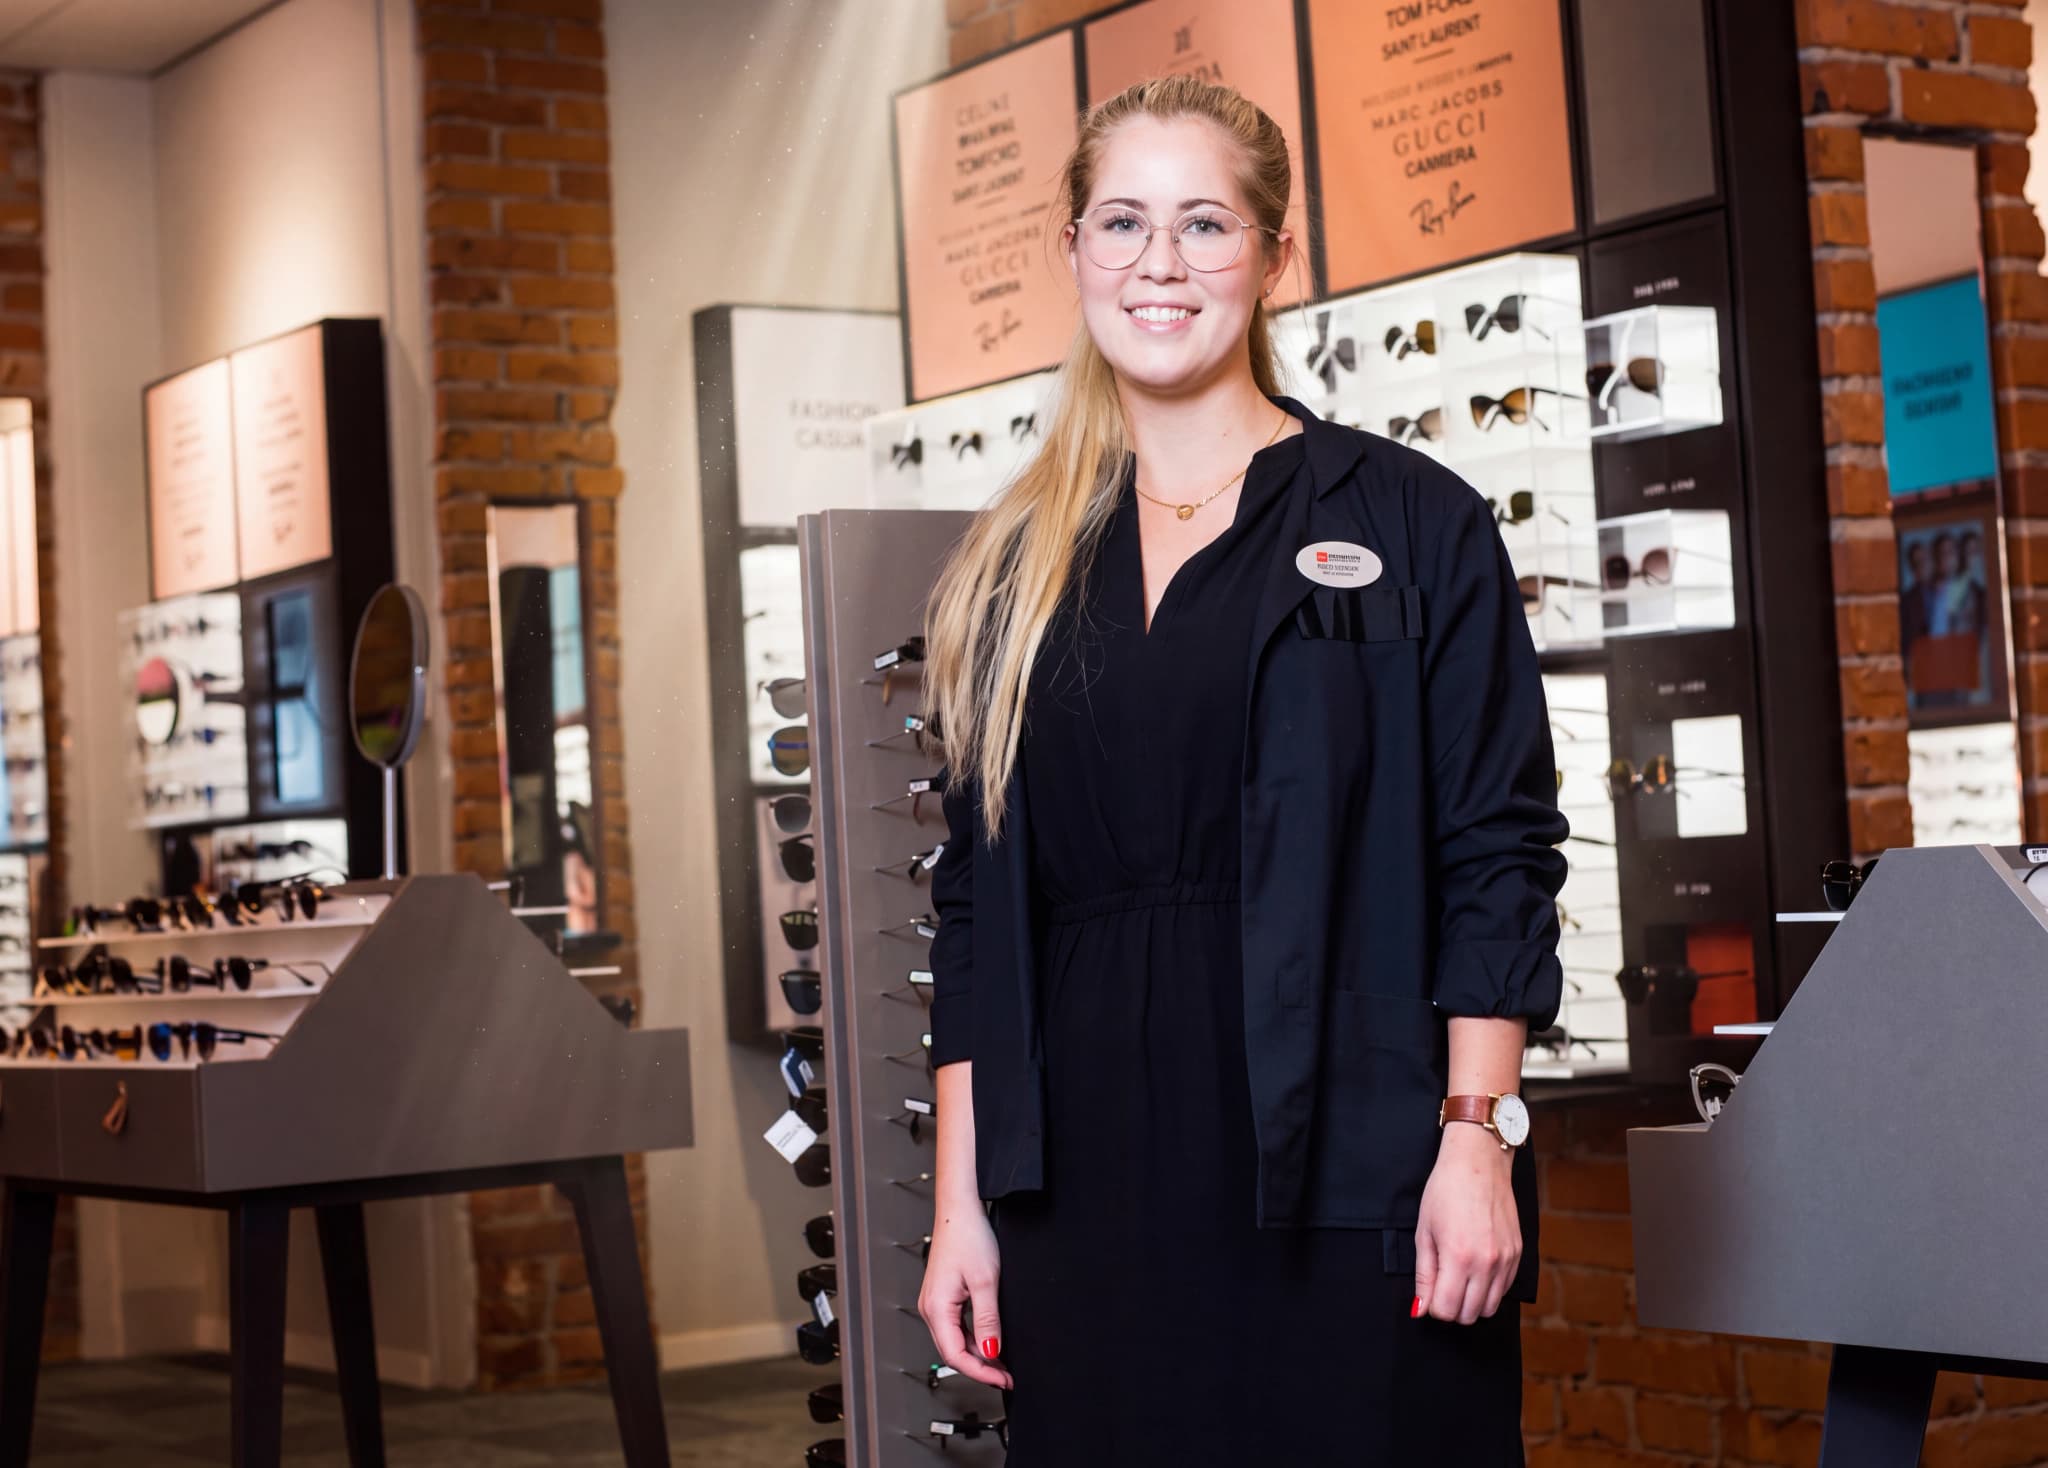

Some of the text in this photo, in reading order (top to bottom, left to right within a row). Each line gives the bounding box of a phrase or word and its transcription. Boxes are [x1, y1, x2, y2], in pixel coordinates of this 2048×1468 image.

[1385, 0, 1473, 30] TOM FO
[1418, 13, 1481, 47] LAURENT
[1371, 103, 1420, 131] MARC
[1428, 79, 1504, 116] JACOBS
[1392, 109, 1486, 157] GUCCI
